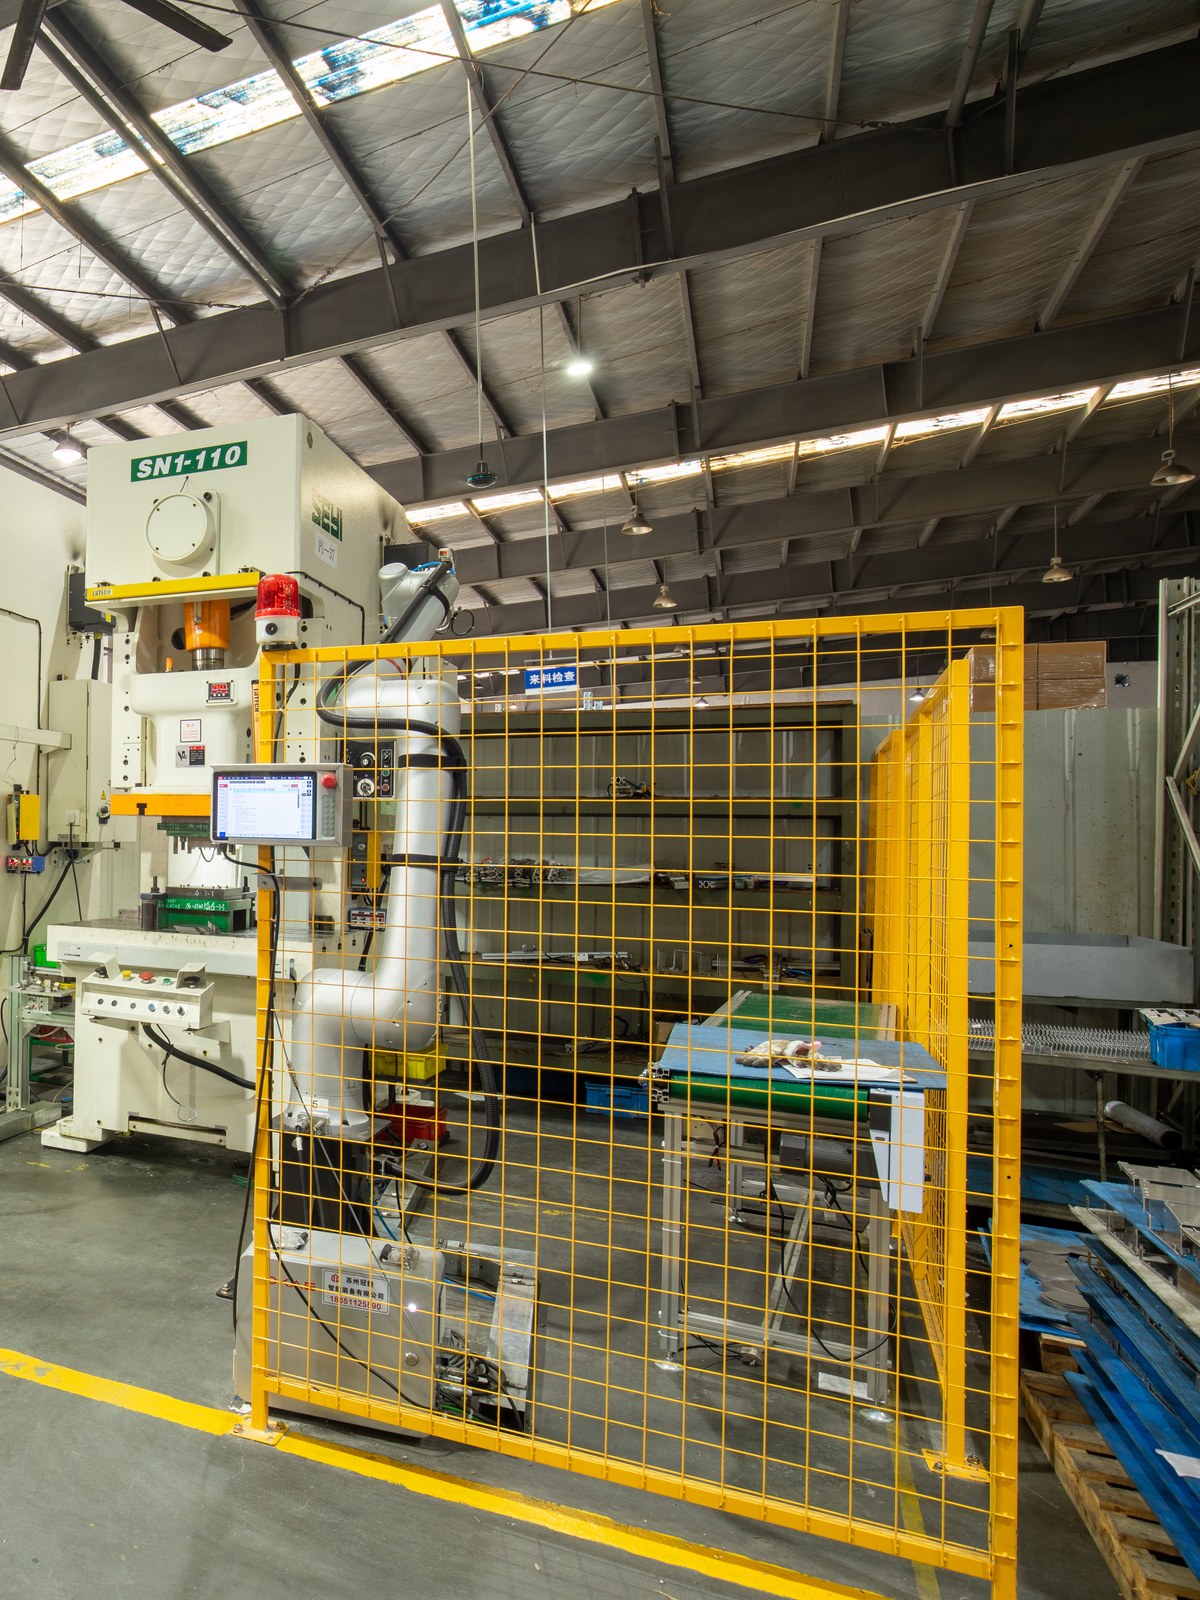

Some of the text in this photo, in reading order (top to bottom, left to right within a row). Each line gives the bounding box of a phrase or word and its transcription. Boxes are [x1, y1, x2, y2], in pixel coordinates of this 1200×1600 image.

[136, 445, 241, 479] SN1-110
[311, 487, 343, 542] SEYI
[529, 671, 576, 685] 来料检查
[312, 1099, 319, 1109] 5
